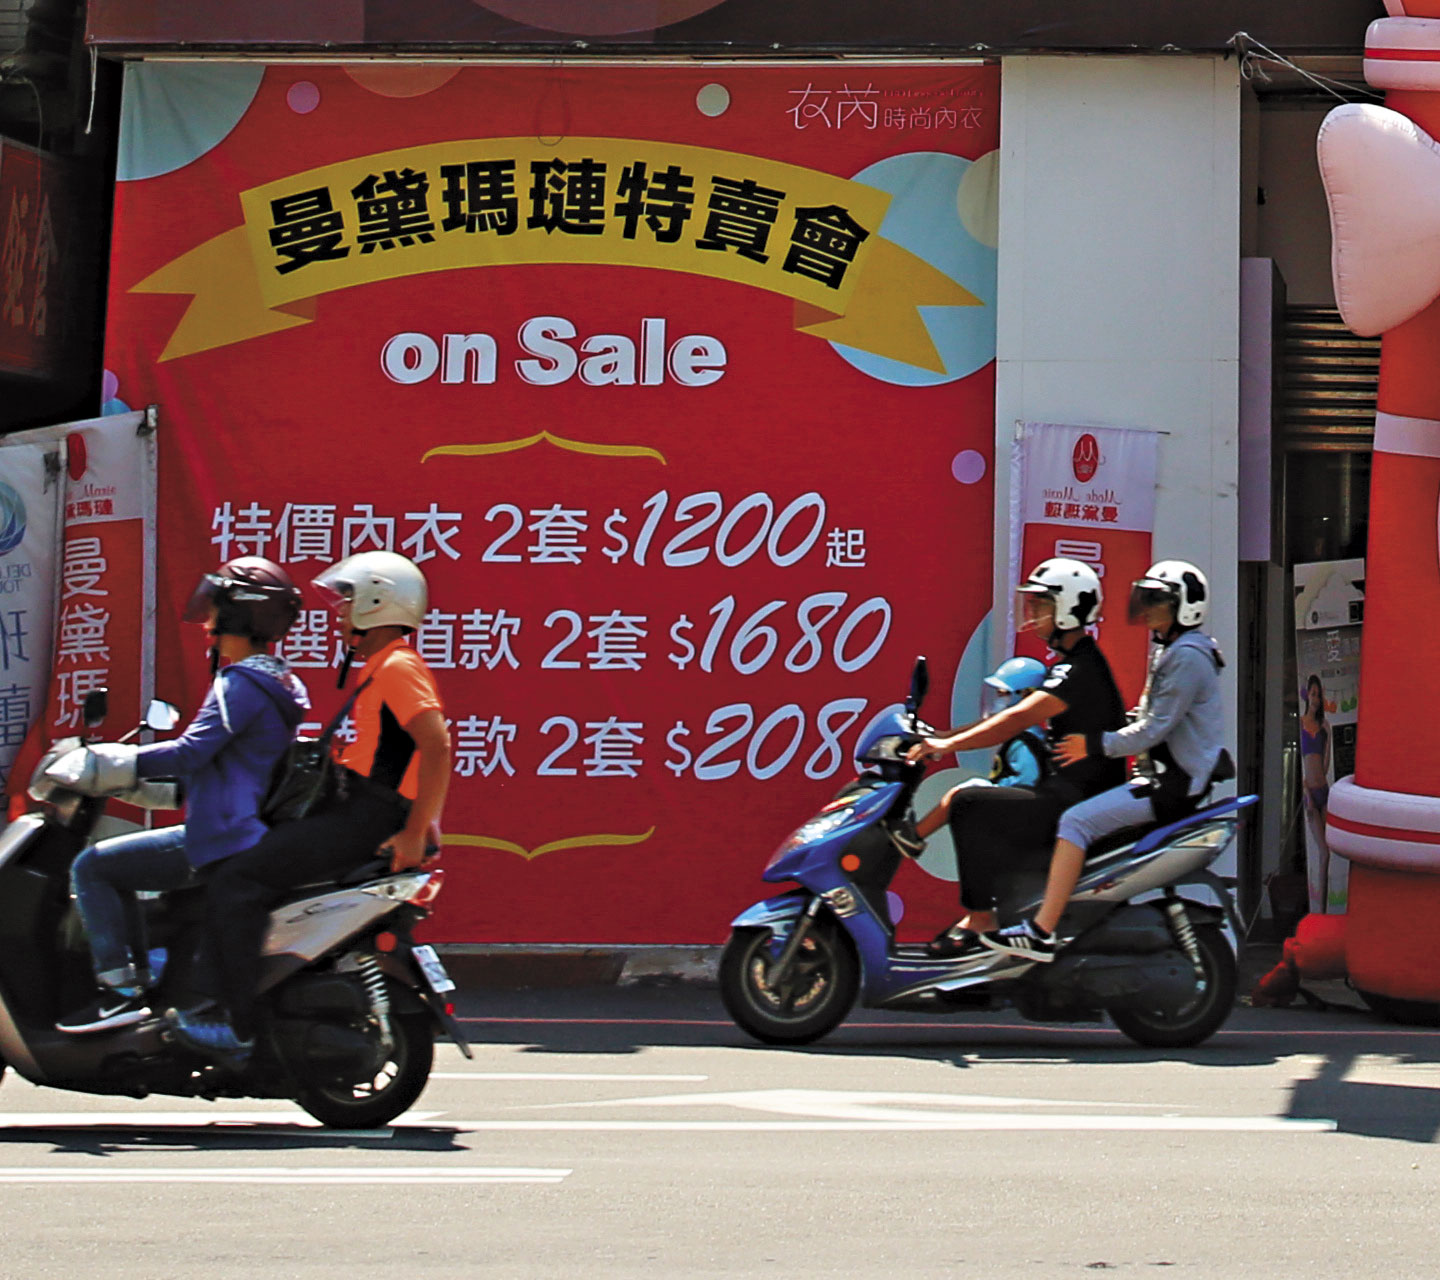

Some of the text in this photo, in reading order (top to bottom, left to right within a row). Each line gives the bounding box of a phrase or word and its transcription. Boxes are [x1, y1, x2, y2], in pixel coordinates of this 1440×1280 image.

[884, 106, 983, 130] 時尚內衣
[267, 157, 871, 290] 曼黛瑪璉特賣會
[380, 316, 728, 387] on Sale
[211, 501, 463, 564] 特價內衣
[481, 503, 588, 565] 2套
[54, 536, 110, 743] 曼黛瑪
[540, 609, 648, 671] 2套
[668, 591, 892, 675] $1680
[536, 715, 644, 778] 2套
